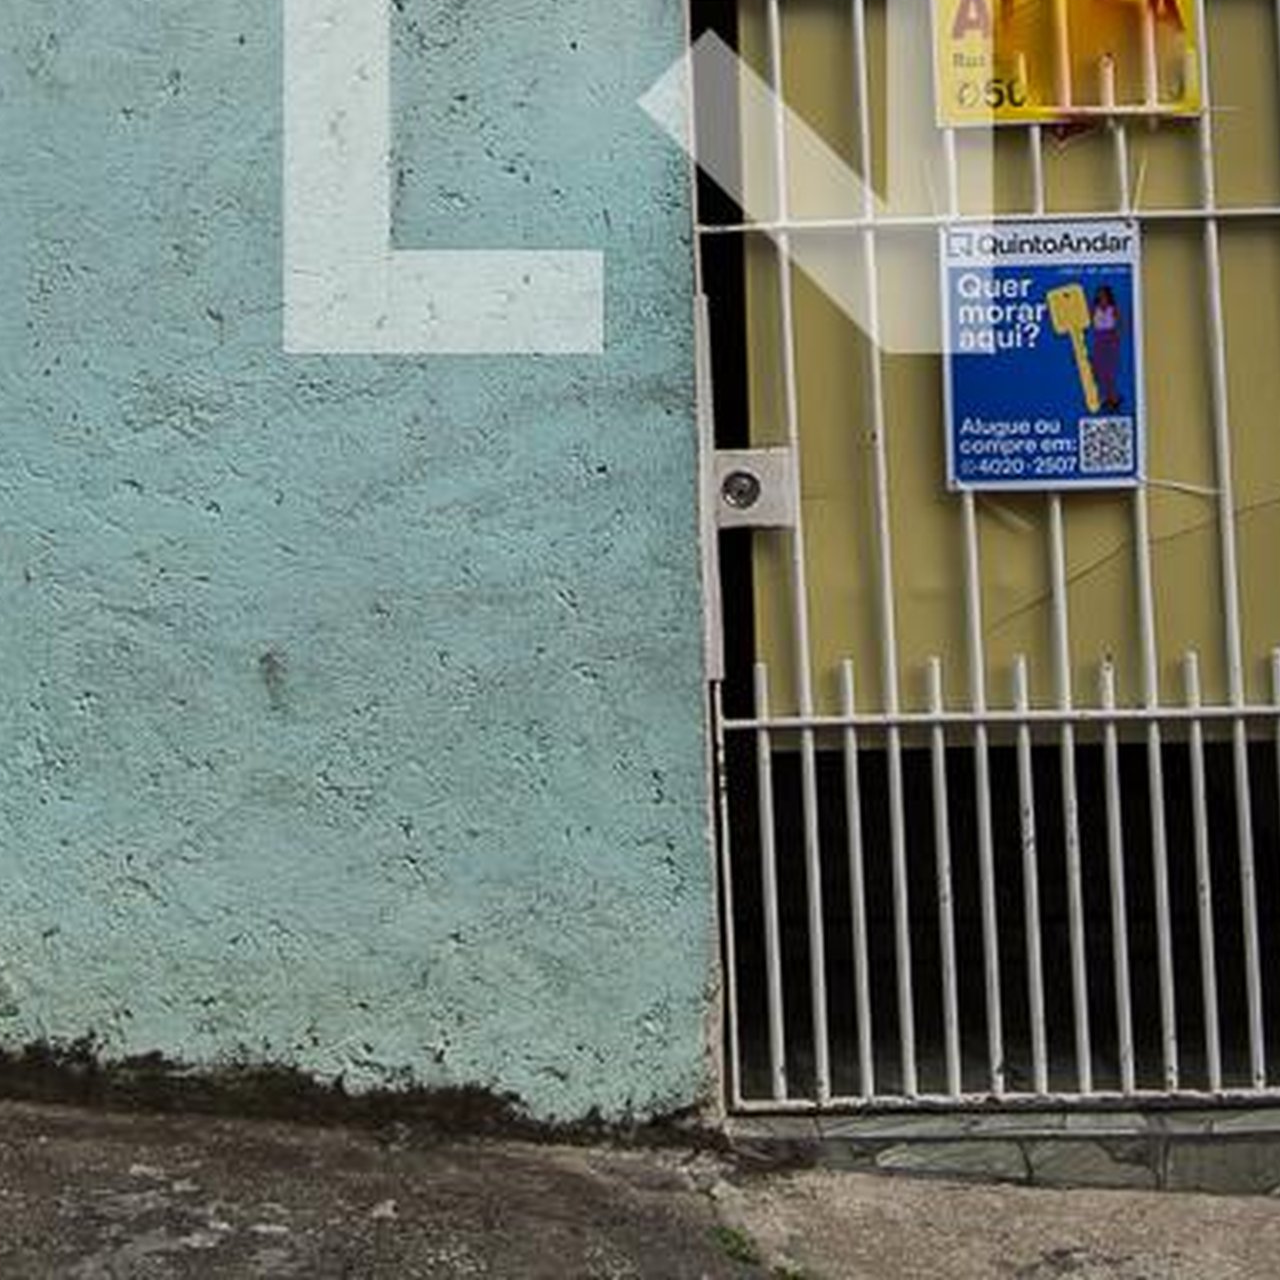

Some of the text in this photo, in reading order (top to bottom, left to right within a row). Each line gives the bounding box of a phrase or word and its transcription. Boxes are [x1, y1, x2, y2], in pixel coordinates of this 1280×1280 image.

[978, 231, 1132, 256] QuintoAndar
[957, 273, 1033, 298] Quer
[958, 302, 1047, 324] morar
[959, 323, 1040, 350] aqui?
[960, 417, 1061, 437] Alugue ou
[960, 438, 1077, 457] compre em:
